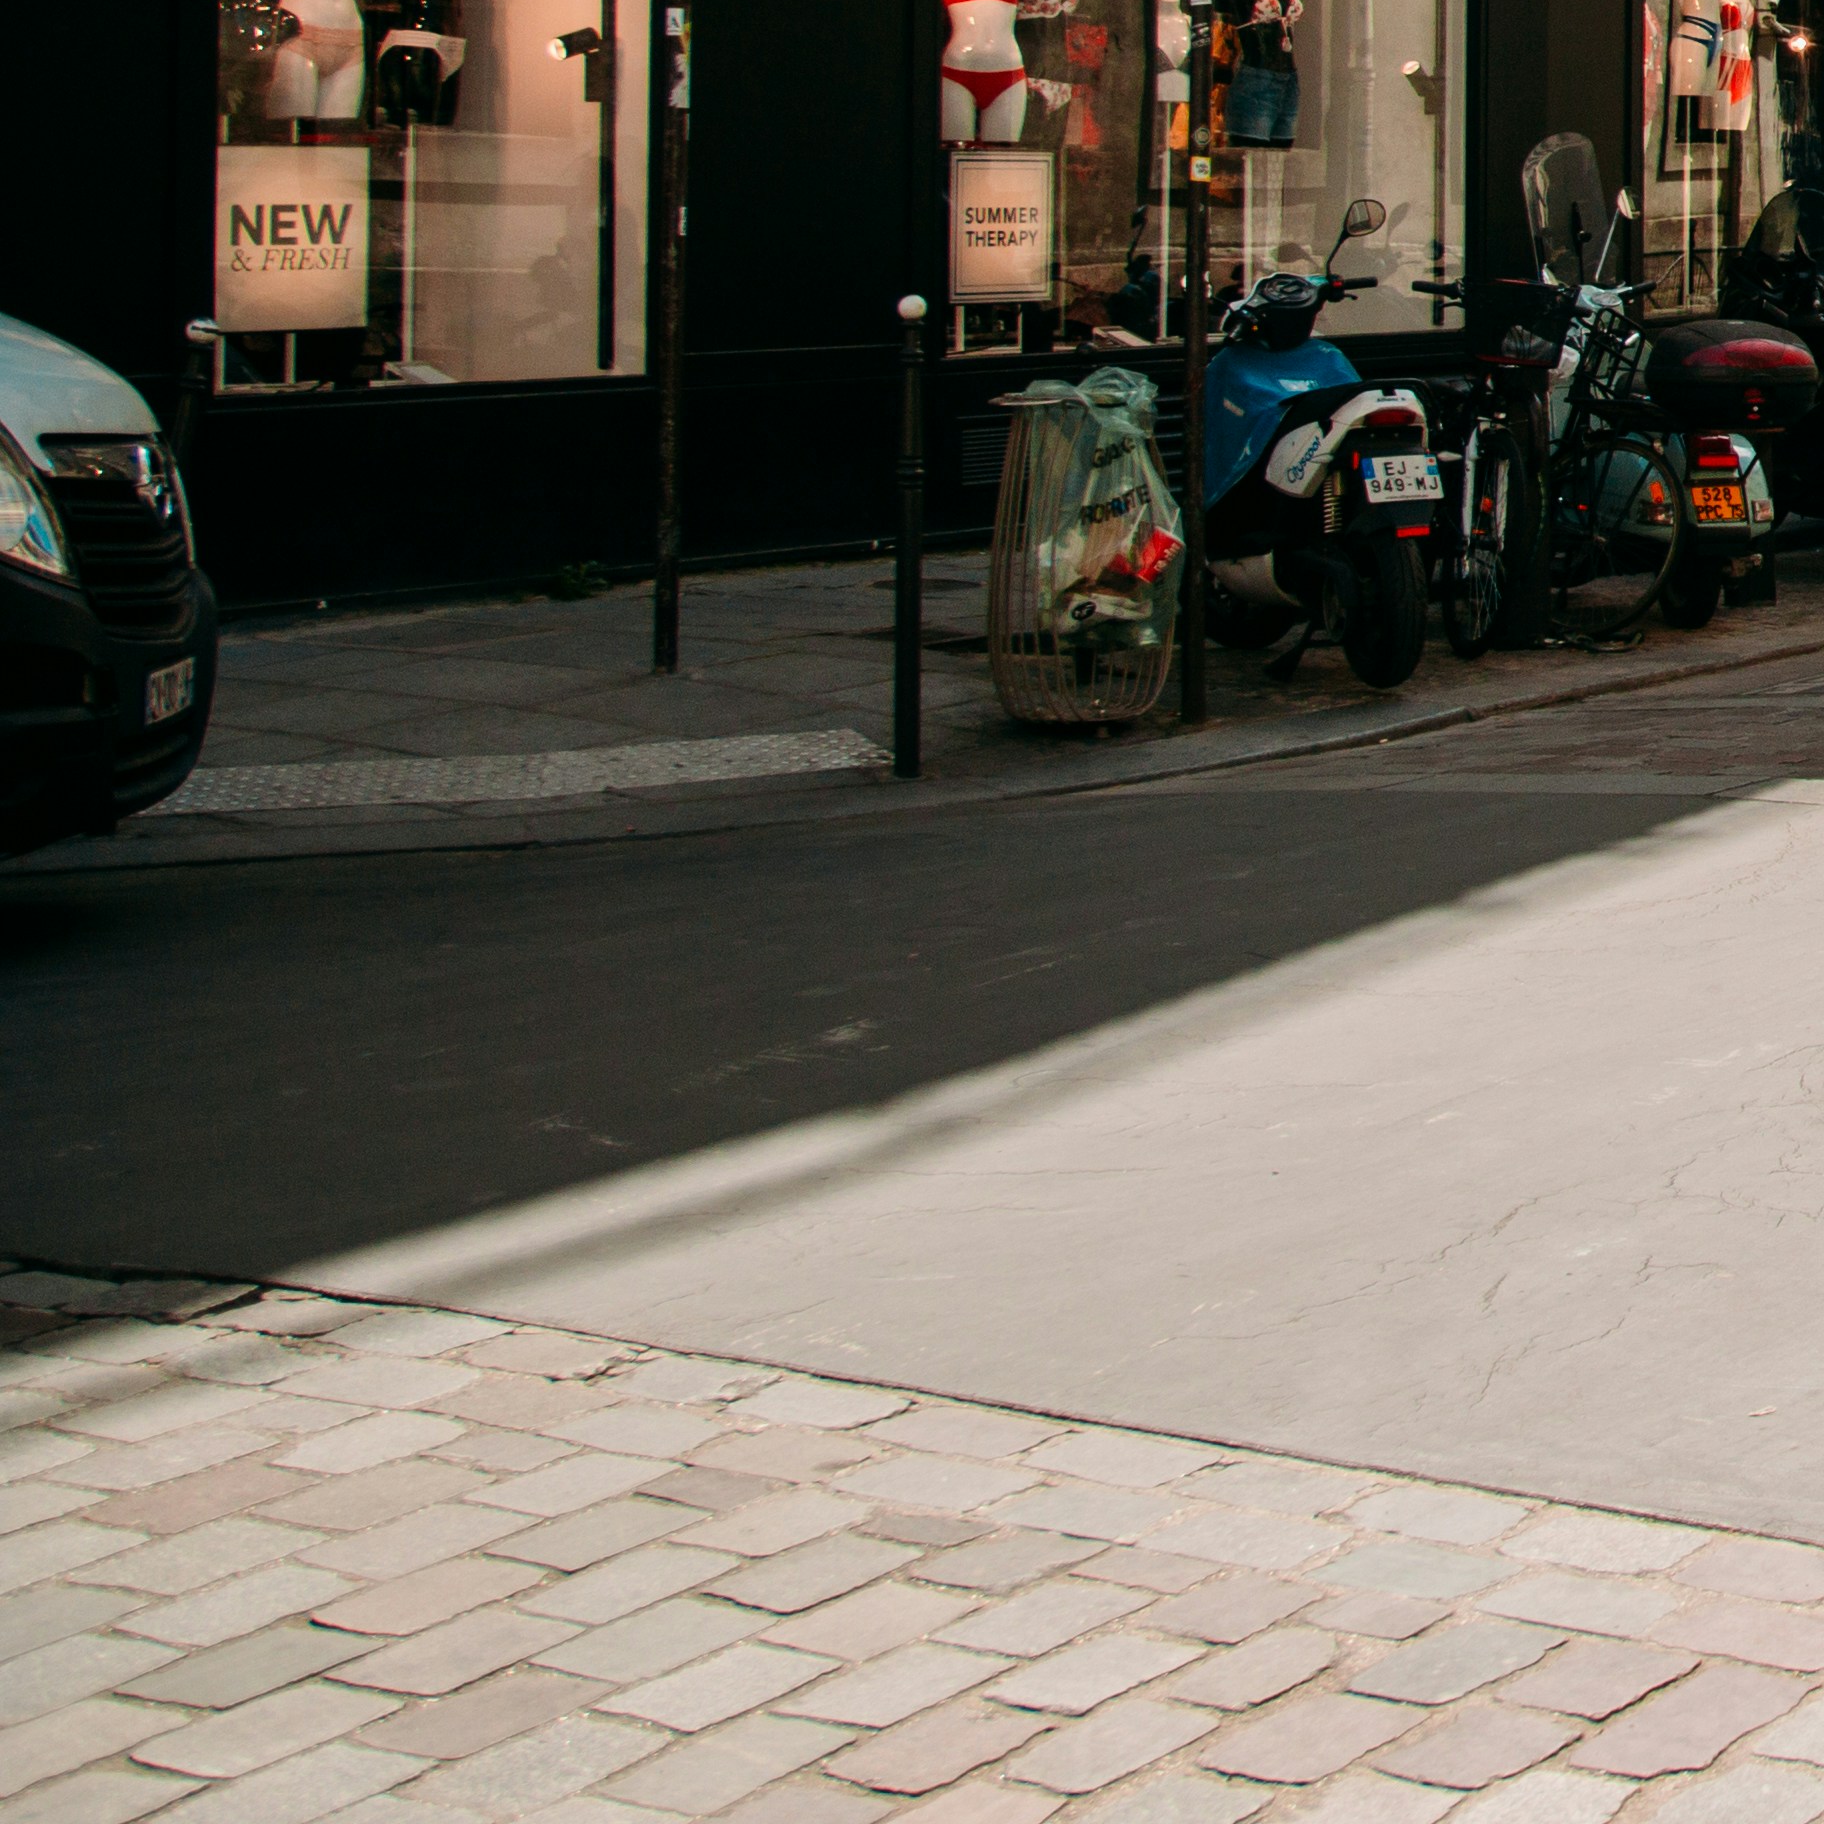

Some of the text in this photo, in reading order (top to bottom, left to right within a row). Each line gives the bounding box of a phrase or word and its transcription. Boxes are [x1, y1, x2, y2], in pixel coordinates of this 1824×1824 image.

[229, 203, 354, 246] NEW
[964, 207, 1039, 225] SUMMER
[965, 230, 1039, 248] THERAPY
[231, 247, 354, 272] & FRESH
[1383, 460, 1407, 476] EJ
[1370, 476, 1439, 494] 949-MJ
[1702, 487, 1733, 503] 528
[1695, 503, 1744, 520] PPC 75
